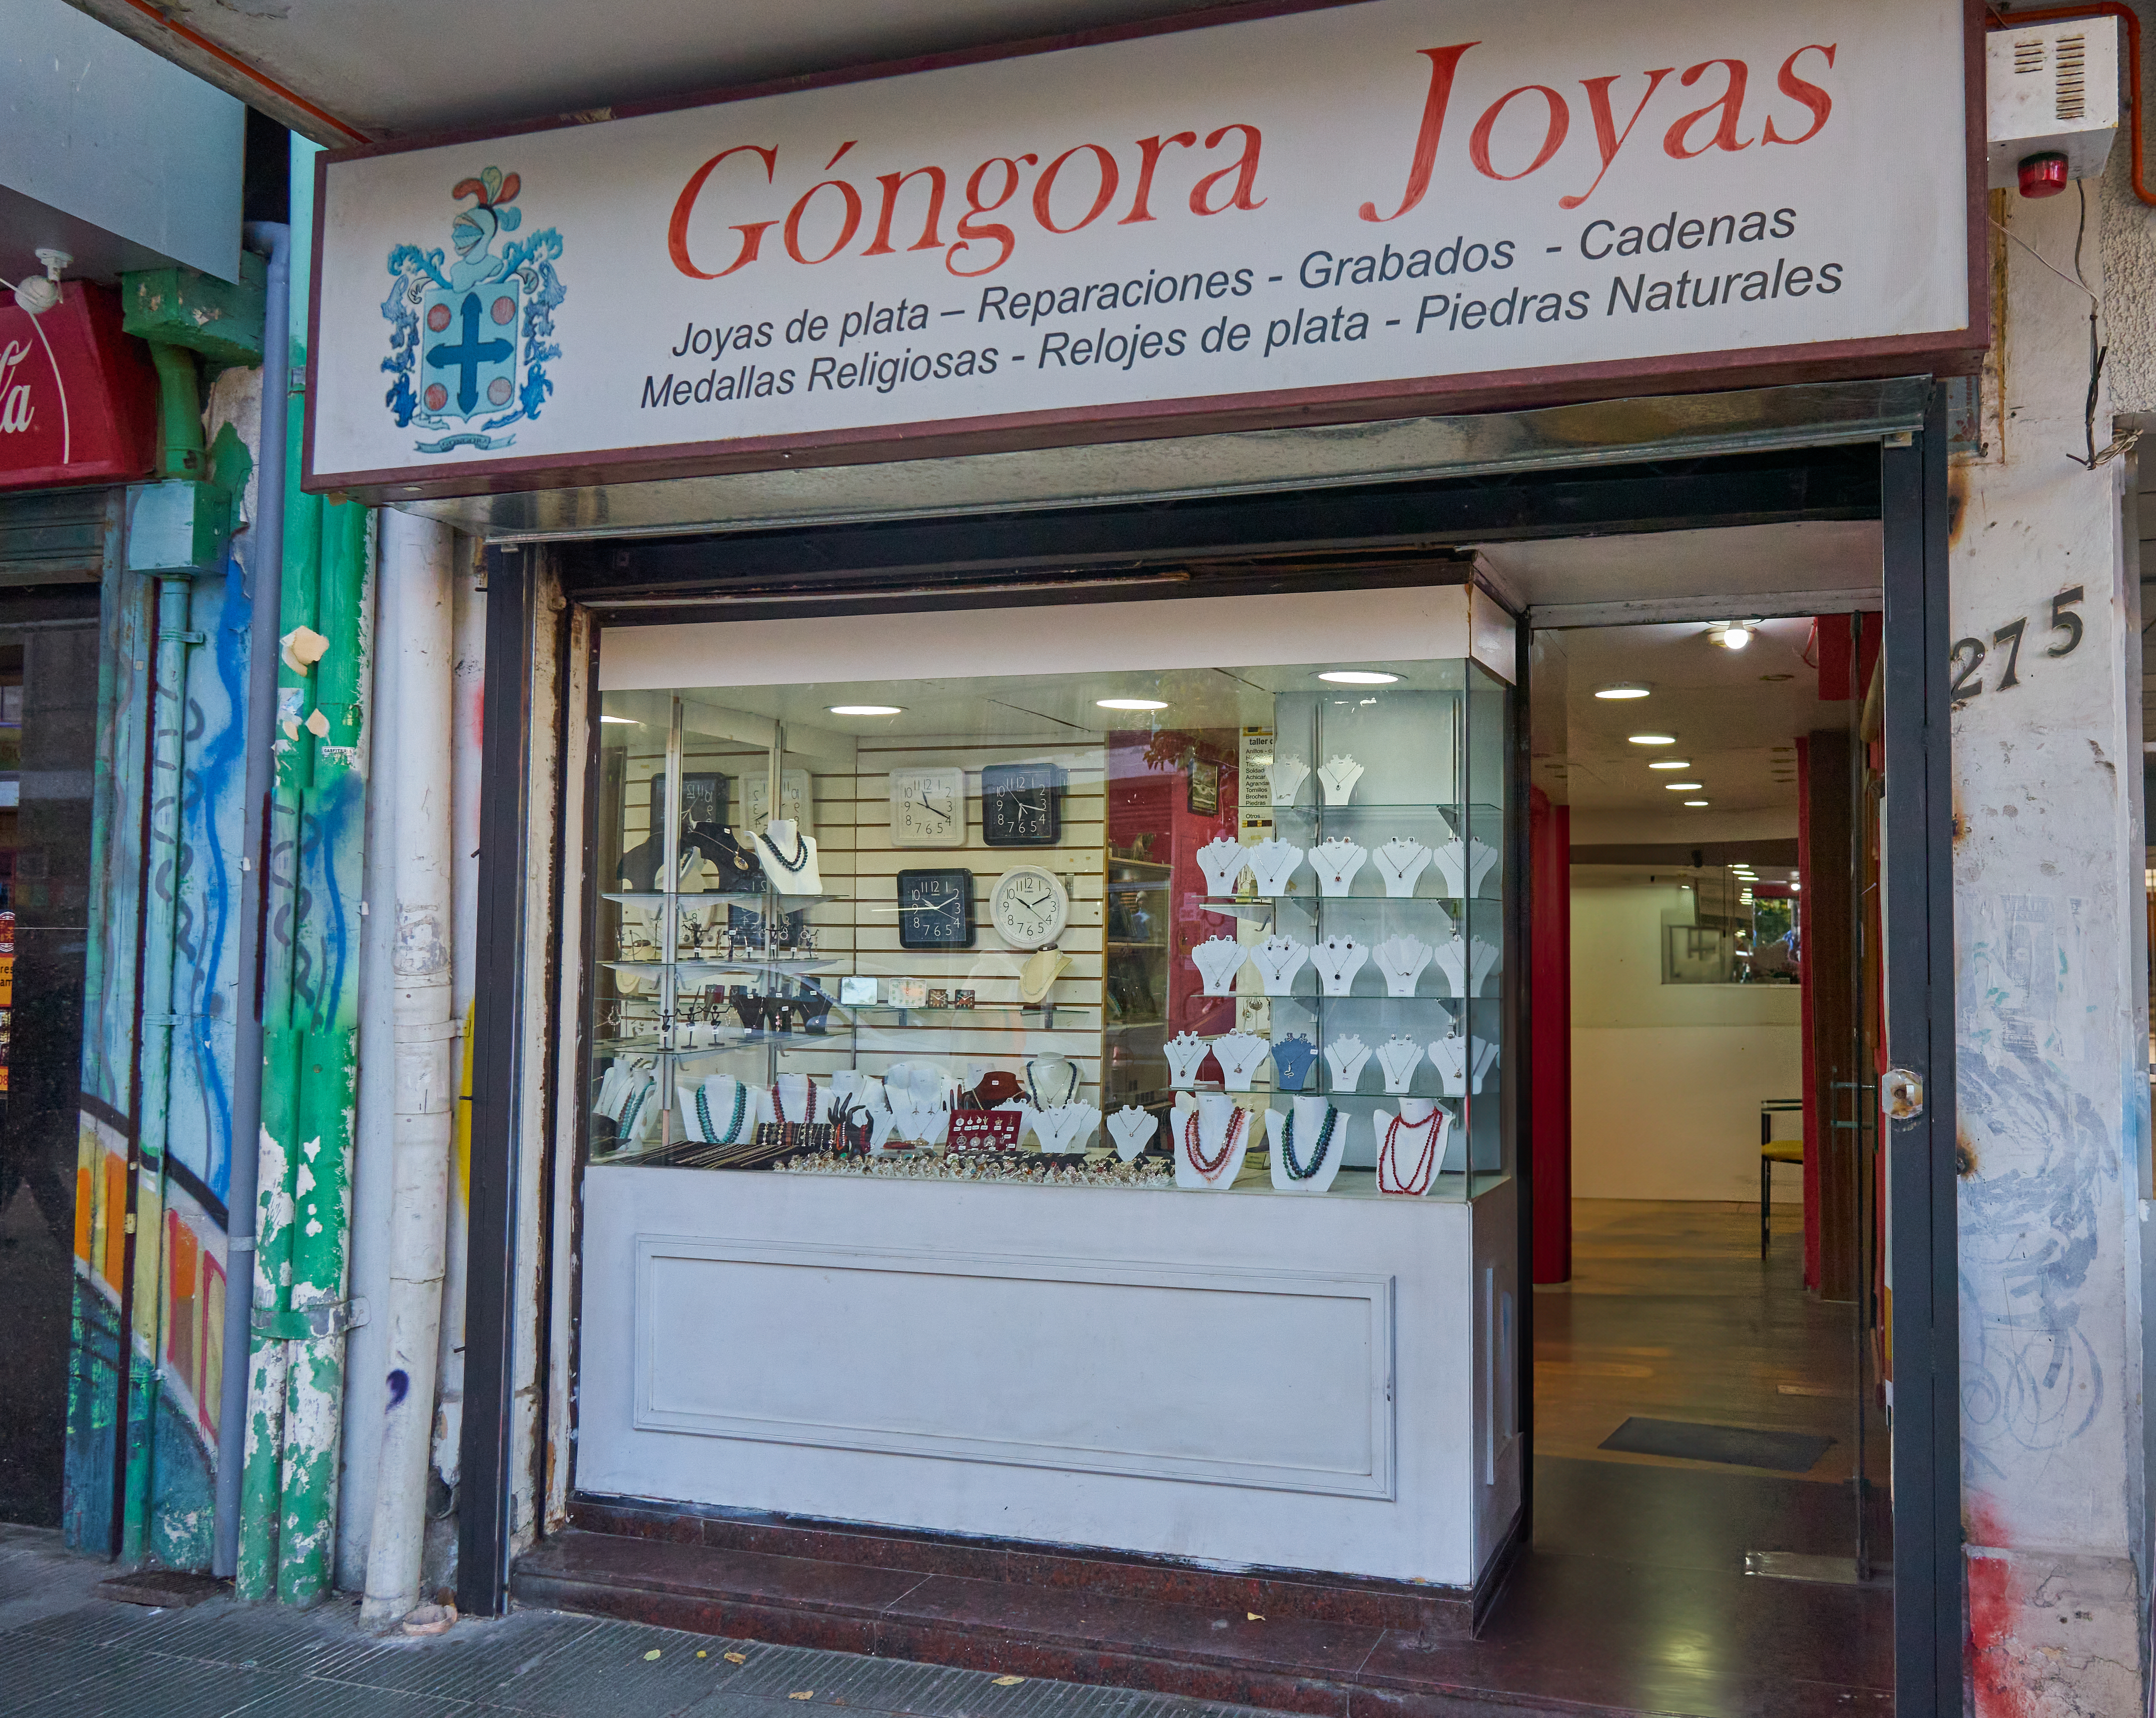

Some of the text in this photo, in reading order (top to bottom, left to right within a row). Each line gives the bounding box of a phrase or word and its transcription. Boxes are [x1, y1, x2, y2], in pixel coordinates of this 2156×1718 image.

[668, 41, 1836, 280] Góngora Joyas
[673, 322, 773, 362] Joyas
[786, 309, 828, 344] de
[839, 299, 928, 347] plata
[978, 269, 1253, 326] Reparaciones
[1300, 236, 1515, 288] Grabados
[1580, 208, 1796, 259] Cadenas
[641, 365, 795, 408] Medallas
[808, 348, 999, 393] Religiosas
[1038, 328, 1187, 370] Relojes
[1201, 316, 1250, 353] de
[1264, 306, 1368, 357] plata
[1416, 287, 1590, 333] Piedras
[1607, 259, 1843, 316] Naturales
[1950, 585, 2083, 702] 275
[924, 779, 932, 790] 12
[1017, 777, 1025, 788] 12
[904, 787, 912, 798] 10
[945, 786, 951, 798] 2
[997, 786, 1005, 797] 10
[1039, 784, 1045, 795] 2
[904, 801, 911, 812] 9
[947, 801, 952, 812] 3
[996, 800, 1003, 811] 9
[1040, 798, 1046, 810] 3
[905, 815, 911, 825] 8
[945, 815, 951, 826] 4
[998, 814, 1004, 825] 8
[1038, 813, 1046, 825] 4
[915, 823, 921, 833] 7
[926, 823, 932, 834] 6
[937, 822, 943, 833] 5
[1007, 822, 1014, 833] 7
[1019, 822, 1025, 833] 6
[1031, 821, 1037, 832] 5
[931, 881, 939, 892] 12
[1025, 877, 1032, 889] 12
[912, 889, 920, 901] 10
[953, 889, 959, 900] 2
[1007, 889, 1015, 900] 10
[1045, 887, 1051, 899] 2
[955, 902, 961, 914] 3
[1003, 902, 1009, 912] 9
[1051, 901, 1056, 912] 3
[914, 917, 920, 928] 8
[953, 917, 960, 928] 4
[1008, 914, 1014, 926] 8
[1045, 914, 1052, 925] 4
[923, 925, 930, 936] 7
[934, 925, 941, 936] 6
[946, 924, 951, 935] 5
[1017, 923, 1024, 933] 7
[1027, 925, 1033, 936] 6
[1038, 922, 1044, 933] 5
